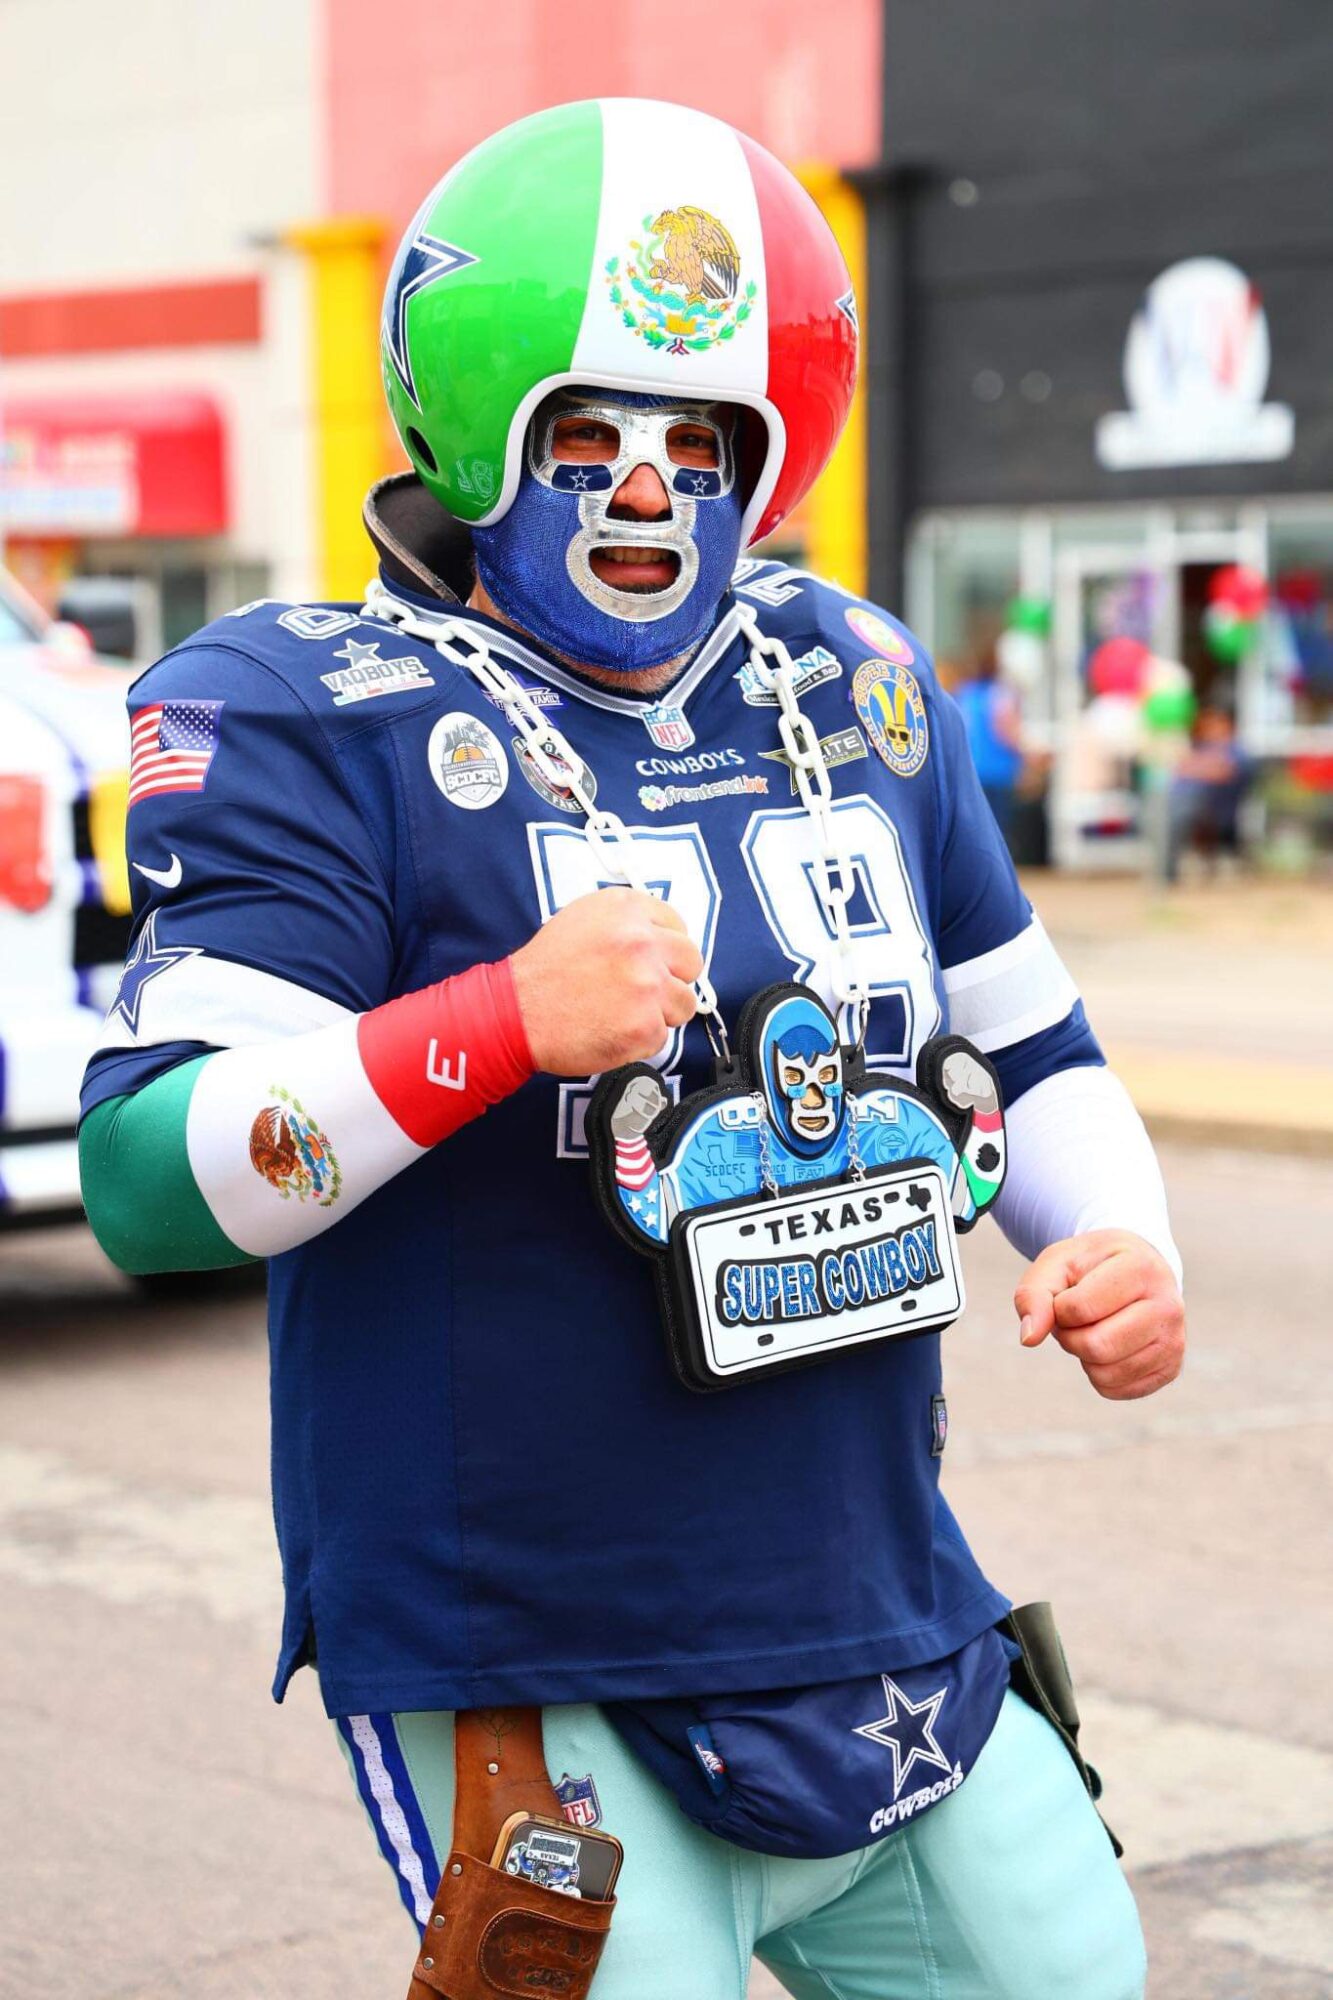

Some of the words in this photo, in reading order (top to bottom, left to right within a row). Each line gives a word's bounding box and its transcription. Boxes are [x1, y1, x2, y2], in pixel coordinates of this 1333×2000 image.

[324, 657, 422, 690] VAQBOYS
[653, 723, 688, 746] NFL
[635, 748, 746, 777] COWBOYS
[764, 1197, 883, 1245] TEXAS
[723, 1261, 824, 1322] SUPER
[824, 1222, 943, 1311] COWBOY
